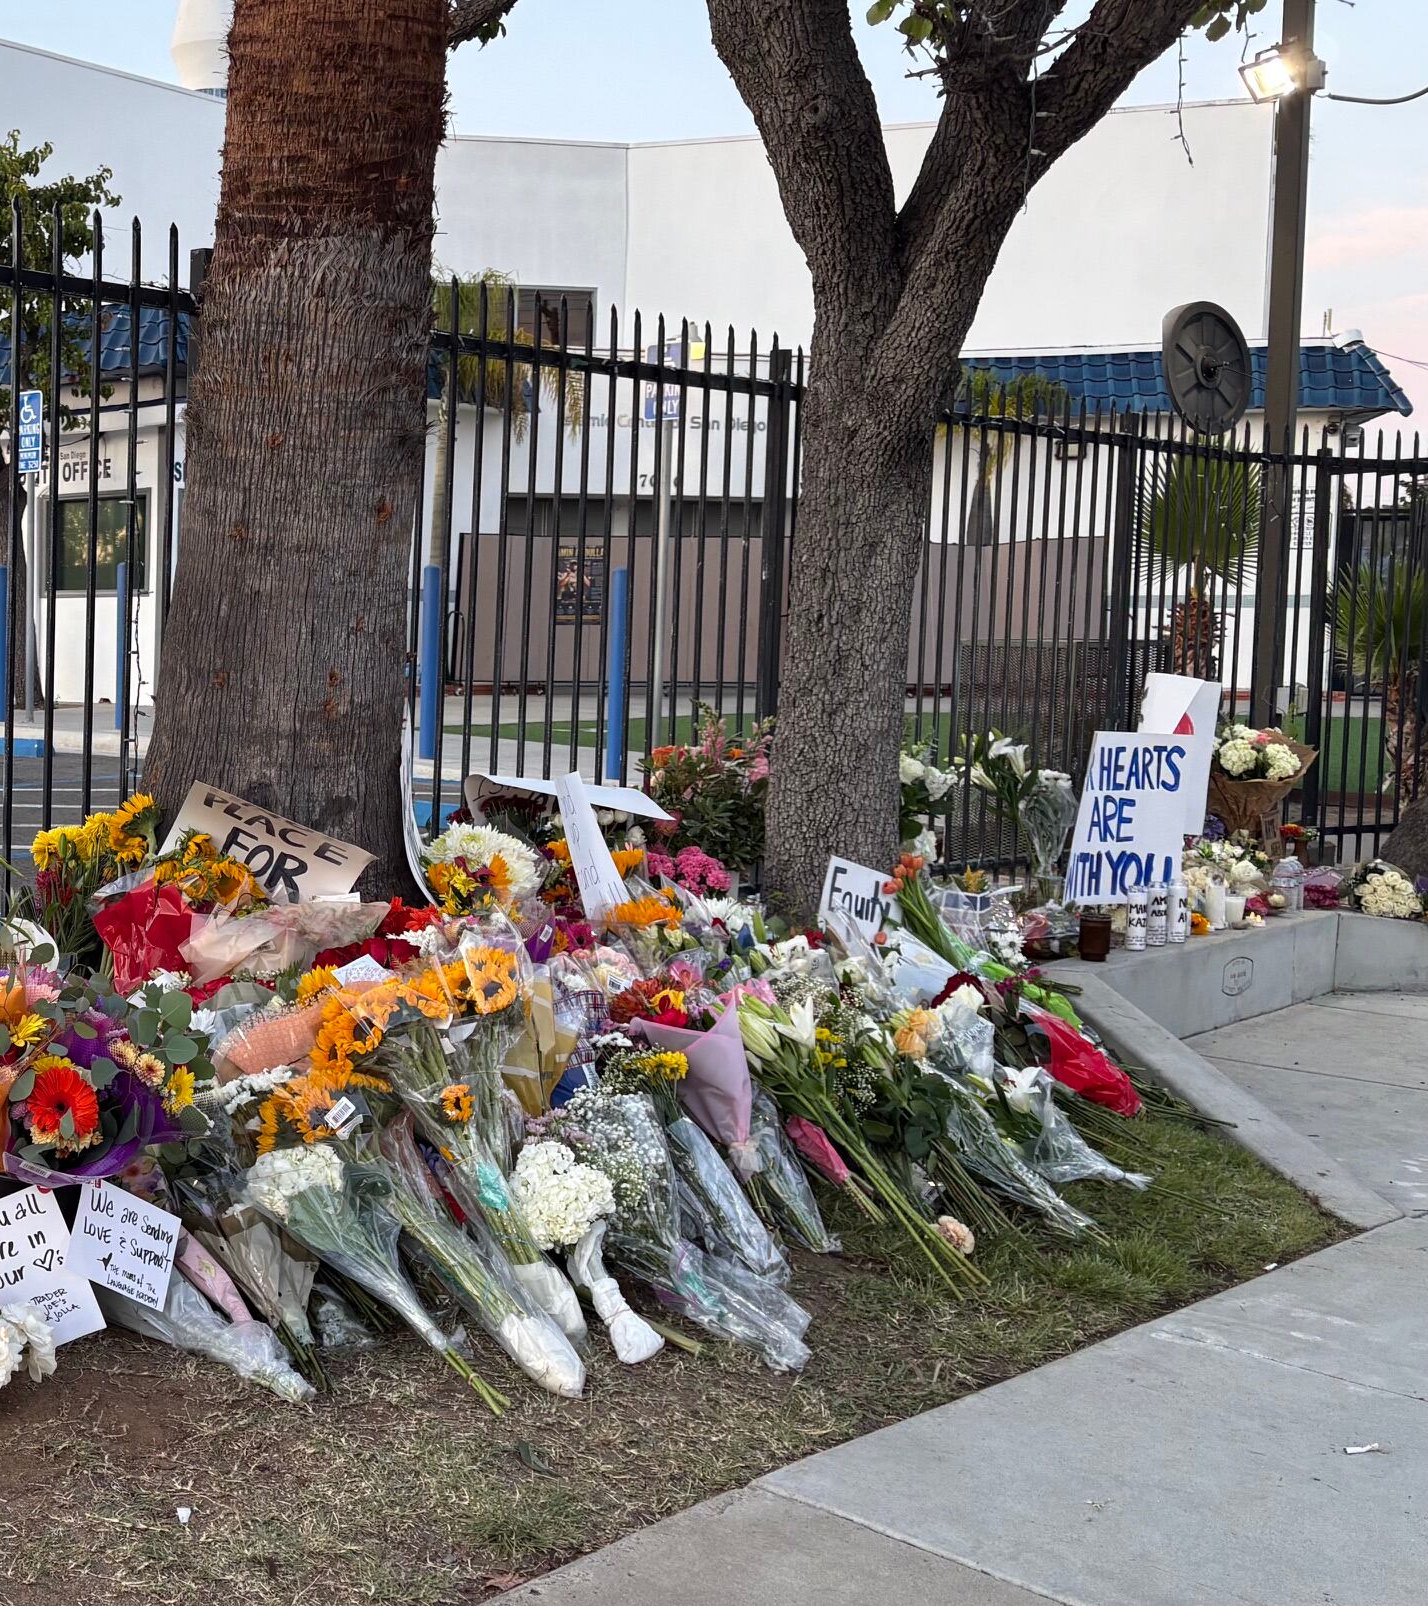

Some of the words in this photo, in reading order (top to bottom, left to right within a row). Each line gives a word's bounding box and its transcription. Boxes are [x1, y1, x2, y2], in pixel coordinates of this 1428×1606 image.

[690, 416, 720, 431] Sn
[62, 458, 111, 482] OFFCE
[1099, 745, 1186, 792] HEARTS
[203, 791, 348, 867] PLACE
[1087, 795, 1136, 842] ARE
[221, 825, 308, 904] FOR
[1105, 850, 1173, 896] YOU
[15, 1193, 46, 1220] all
[91, 1188, 114, 1218] We
[120, 1207, 138, 1226] are
[27, 1230, 46, 1249] in
